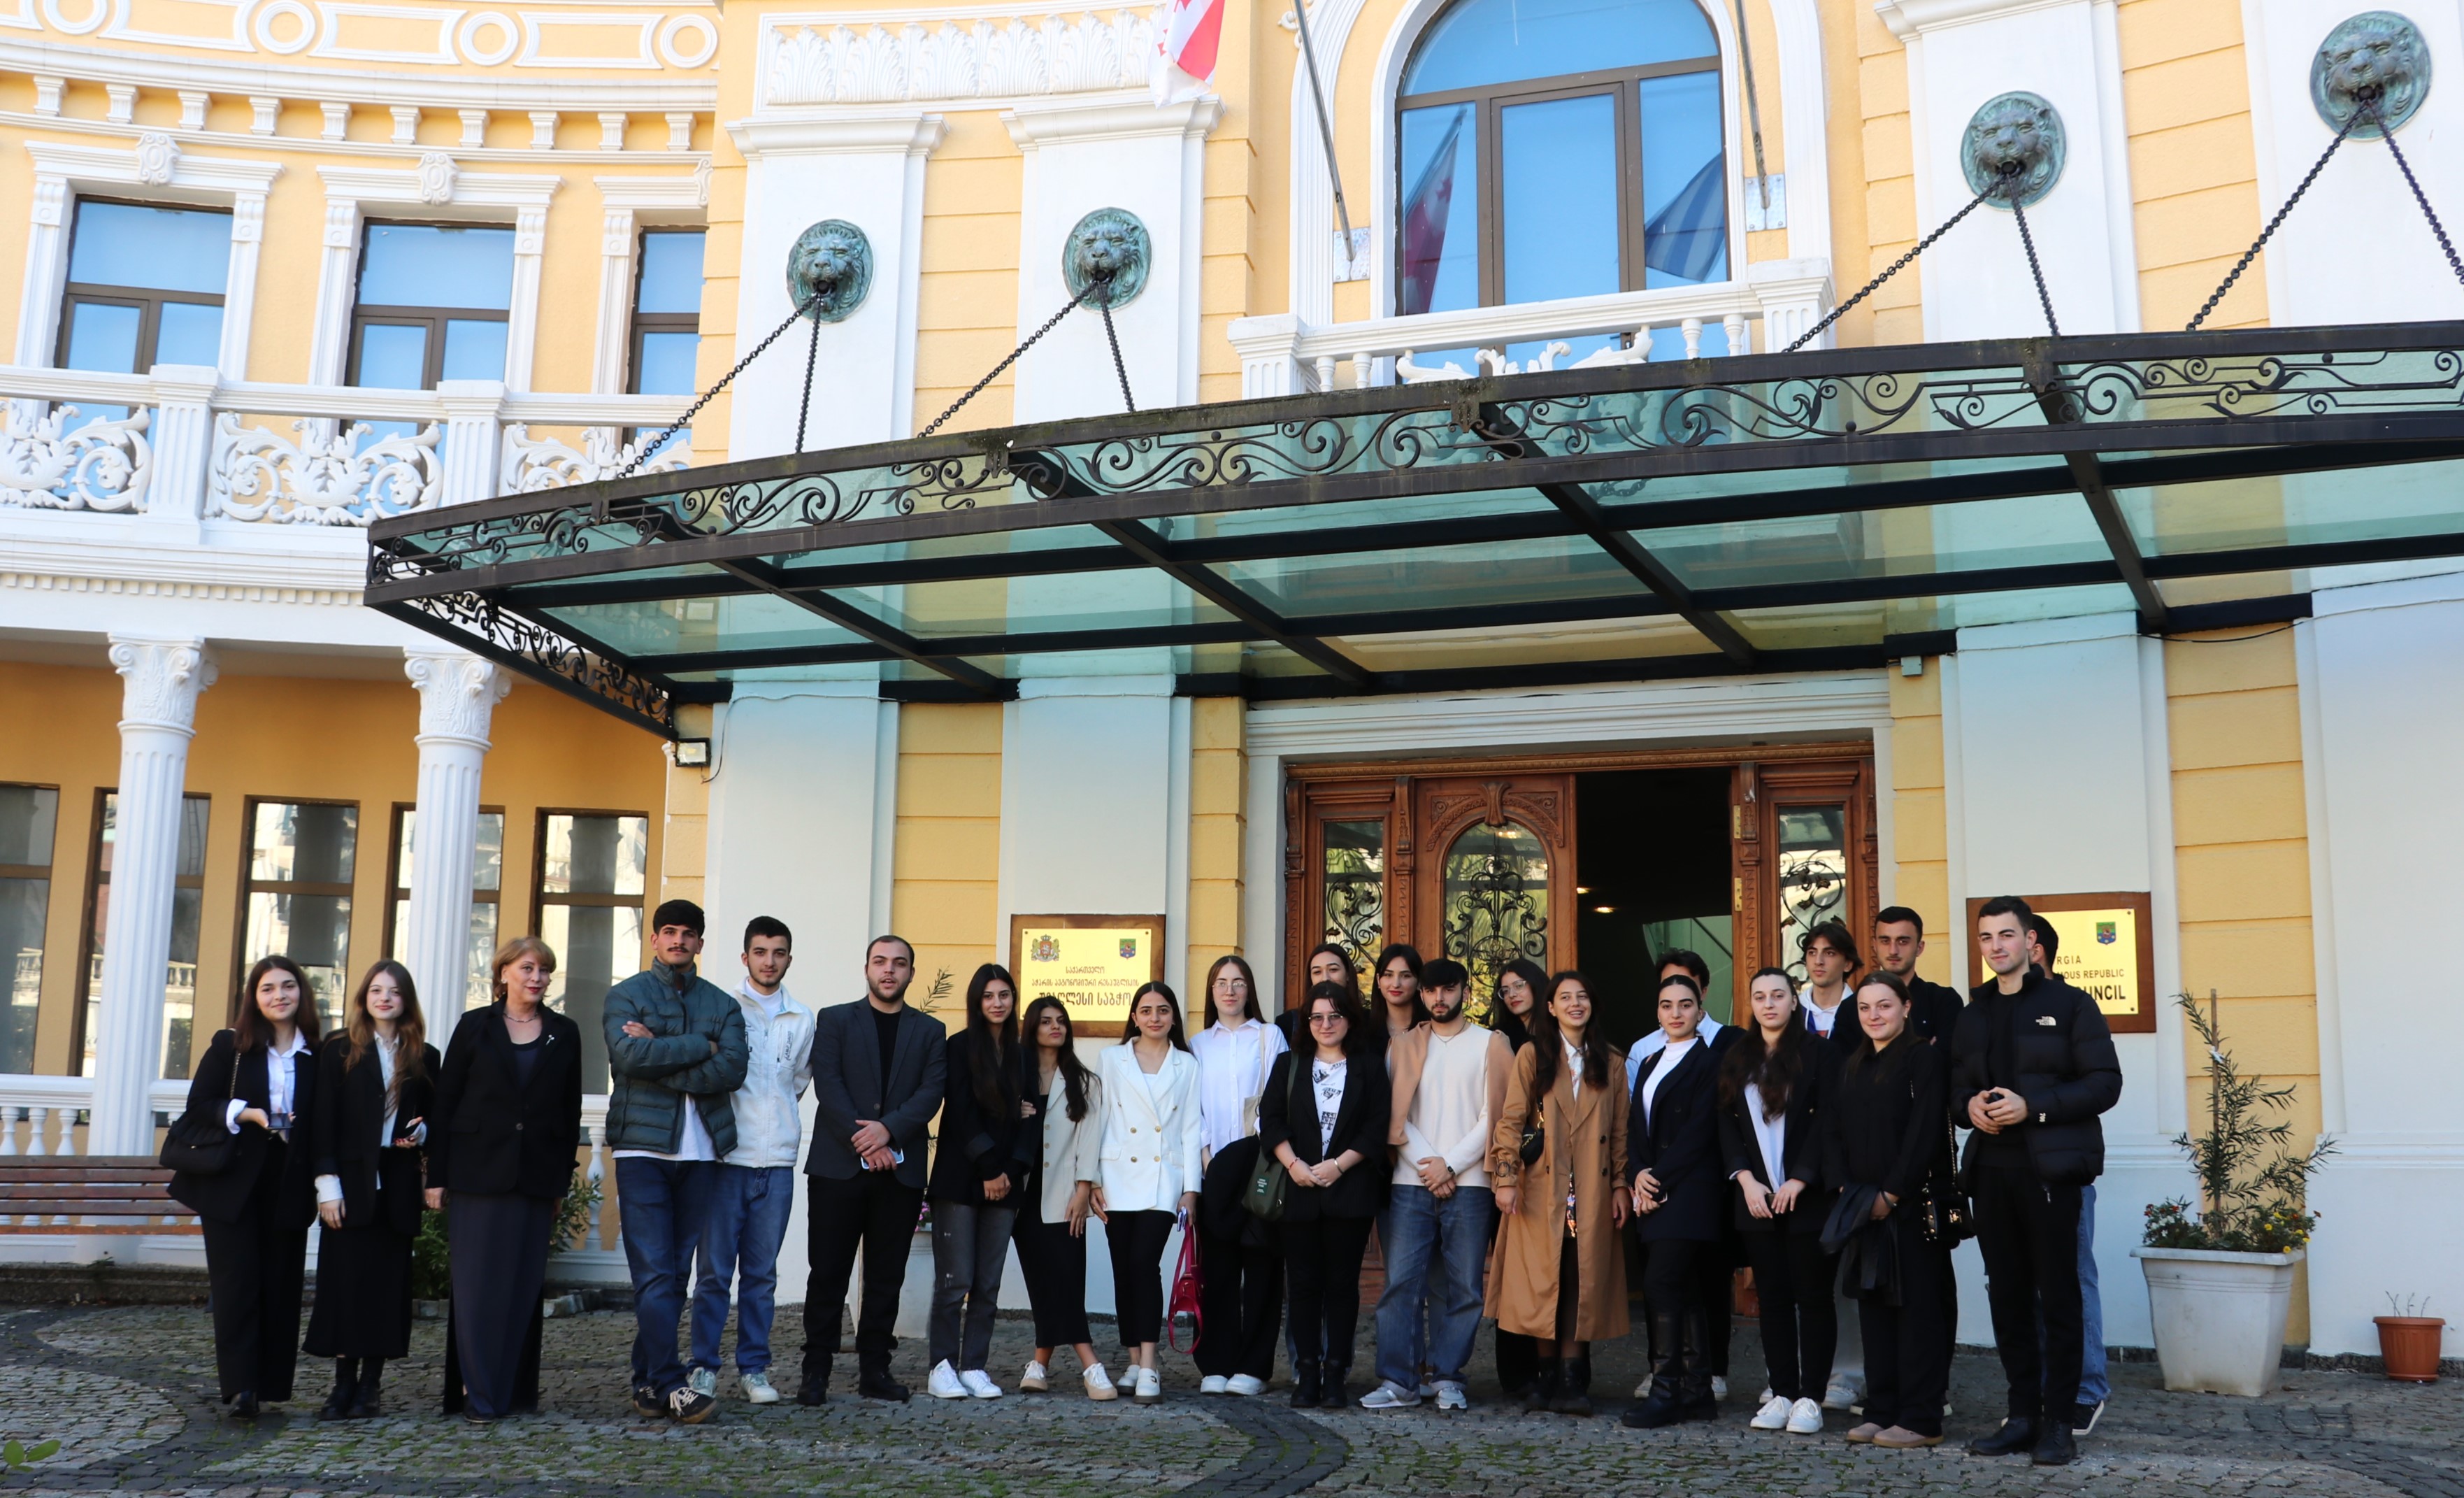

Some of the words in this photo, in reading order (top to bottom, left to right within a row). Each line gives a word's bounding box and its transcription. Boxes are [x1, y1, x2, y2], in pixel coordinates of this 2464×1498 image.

[2056, 955, 2082, 964] RGIA
[2084, 969, 2124, 978] REPUBLIC
[1097, 992, 1131, 1006] საბჭო
